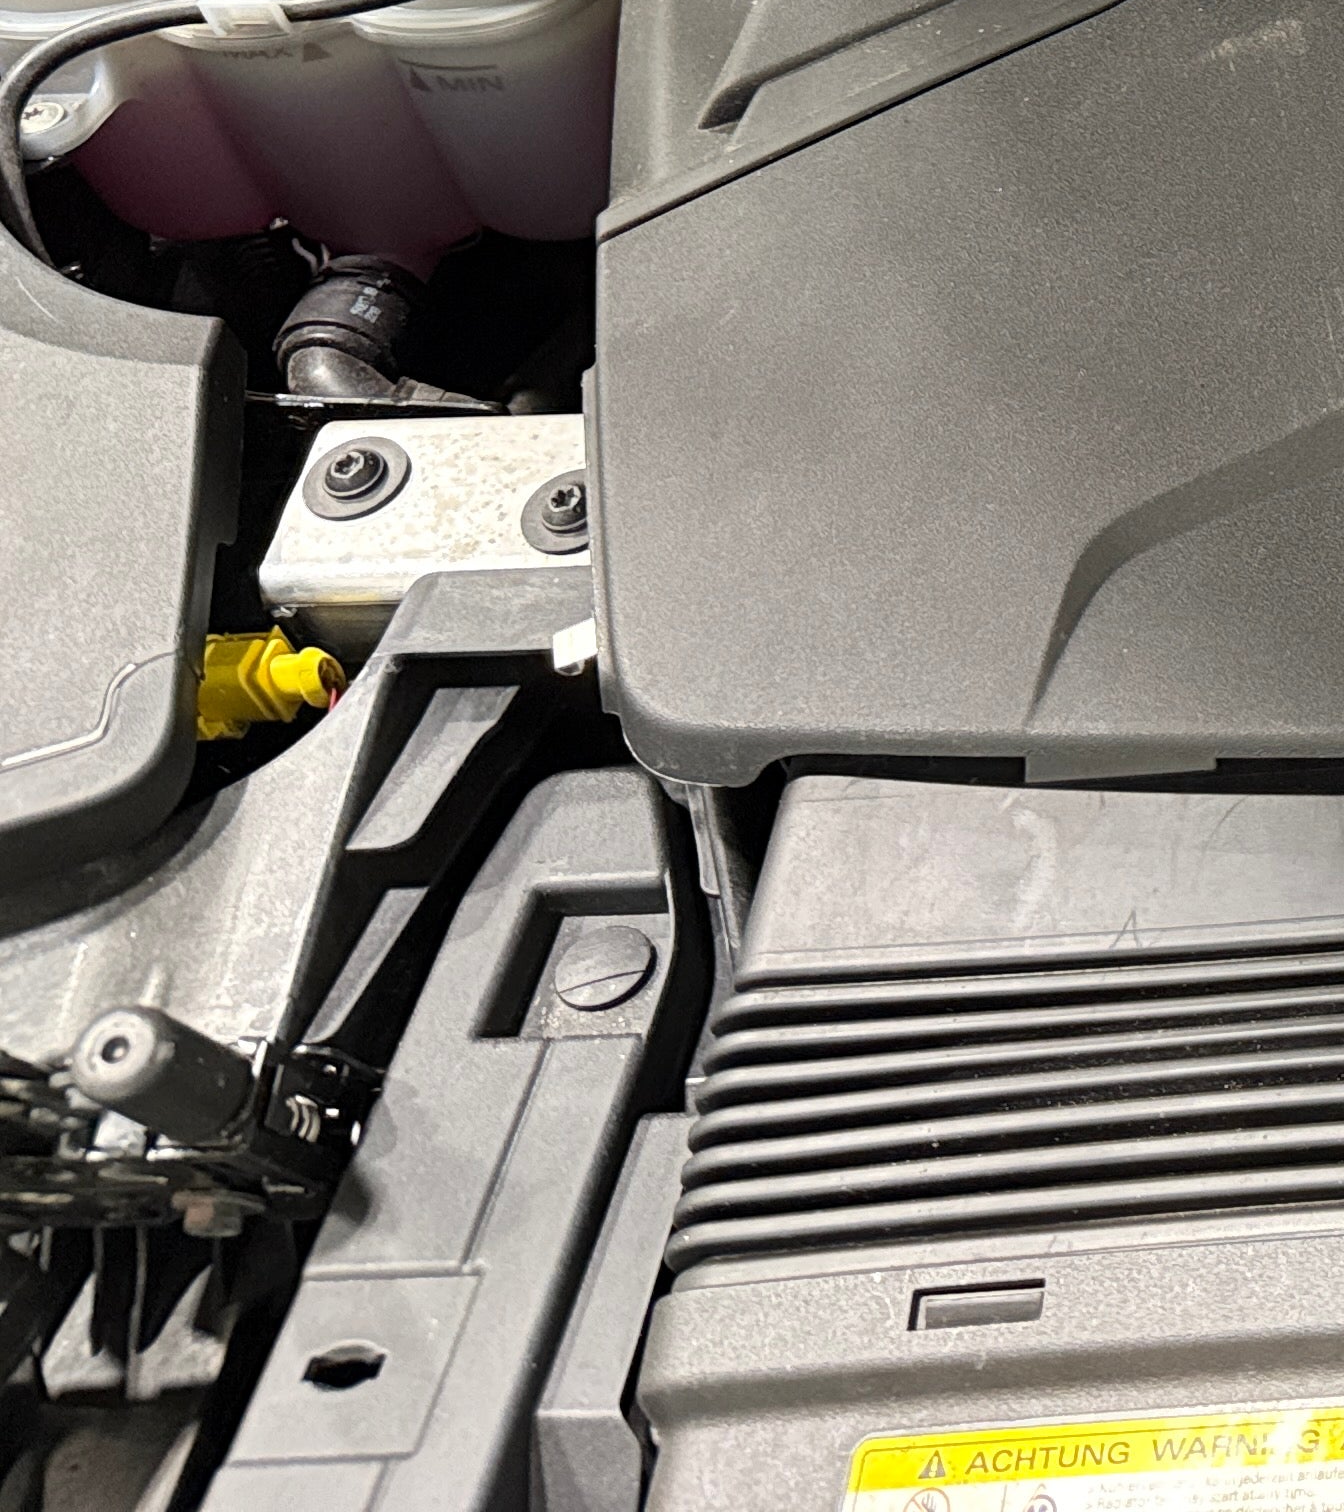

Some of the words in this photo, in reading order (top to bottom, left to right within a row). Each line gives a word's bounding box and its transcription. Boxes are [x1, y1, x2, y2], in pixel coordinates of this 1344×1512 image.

[436, 74, 503, 93] MIN
[964, 1441, 1132, 1476] ACHTUNG
[1152, 1428, 1321, 1462] WARNIG
